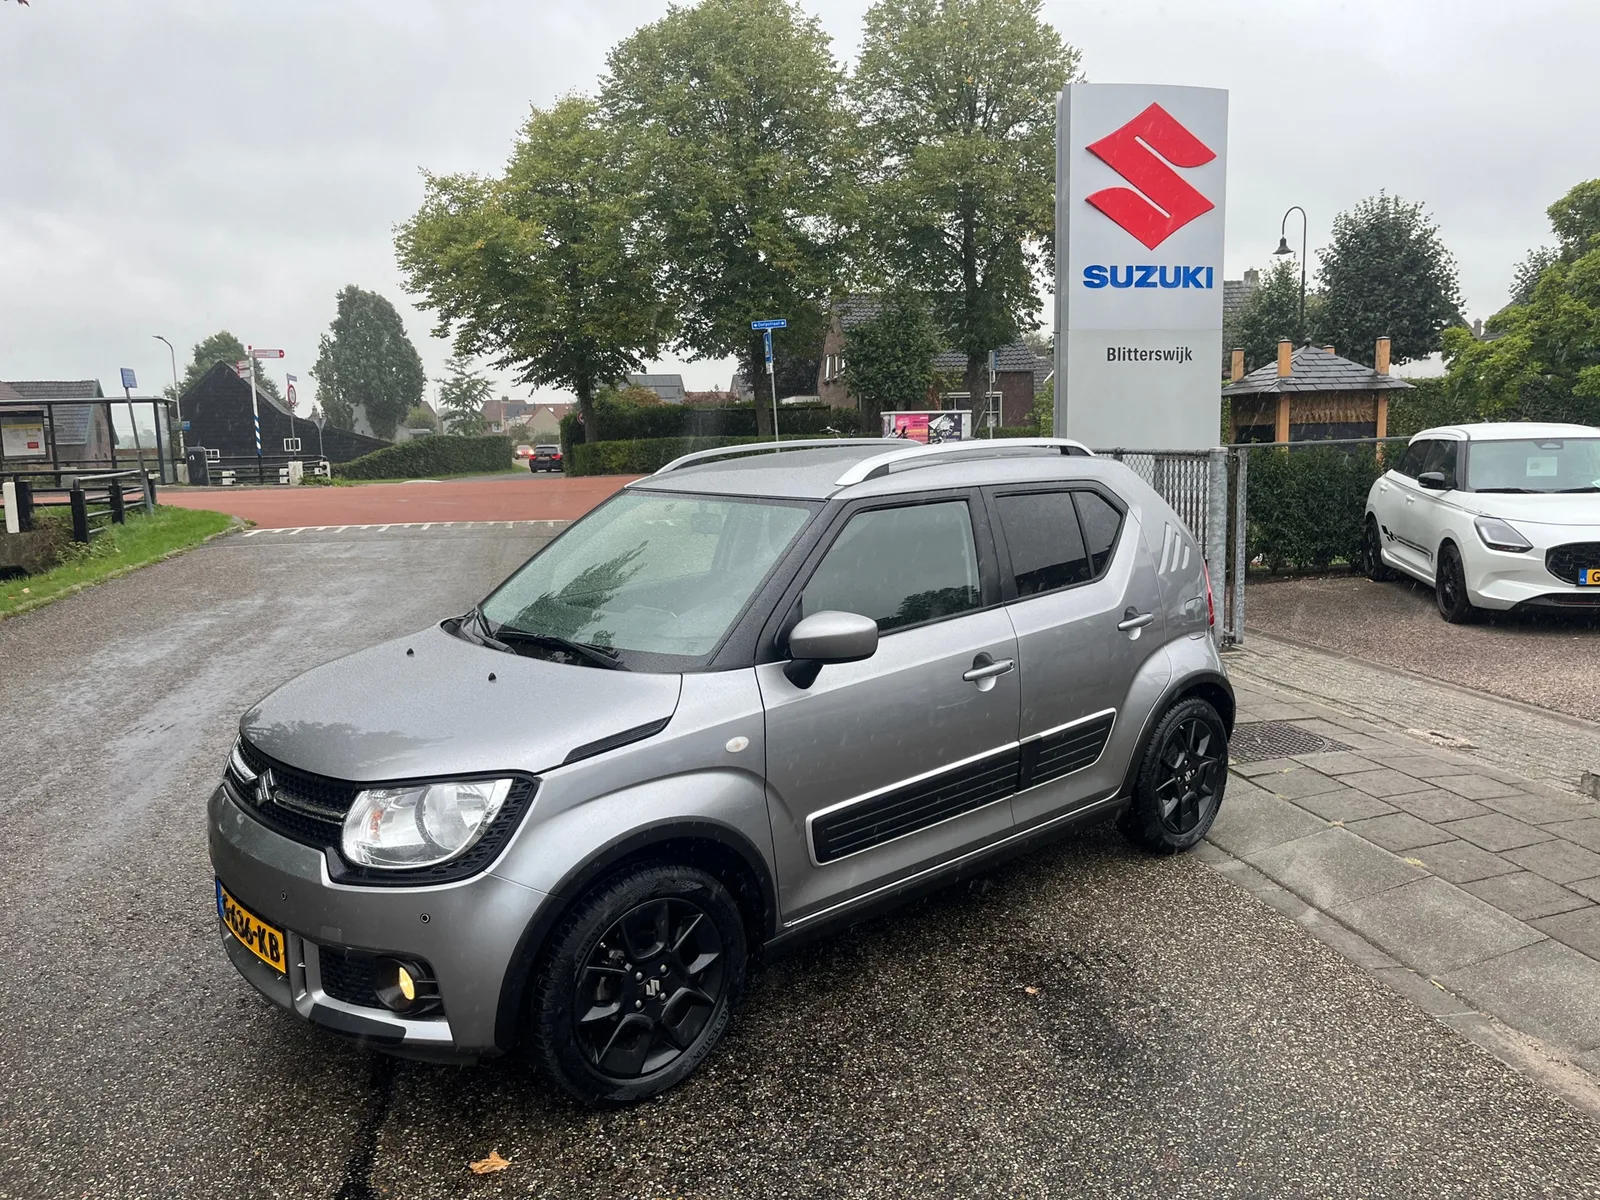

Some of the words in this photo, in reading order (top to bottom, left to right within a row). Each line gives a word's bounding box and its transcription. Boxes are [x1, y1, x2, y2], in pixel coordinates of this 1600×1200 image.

[1083, 265, 1213, 289] SUZUKI
[1106, 346, 1193, 364] Blitterswijk
[222, 893, 281, 963] G-636-KB
